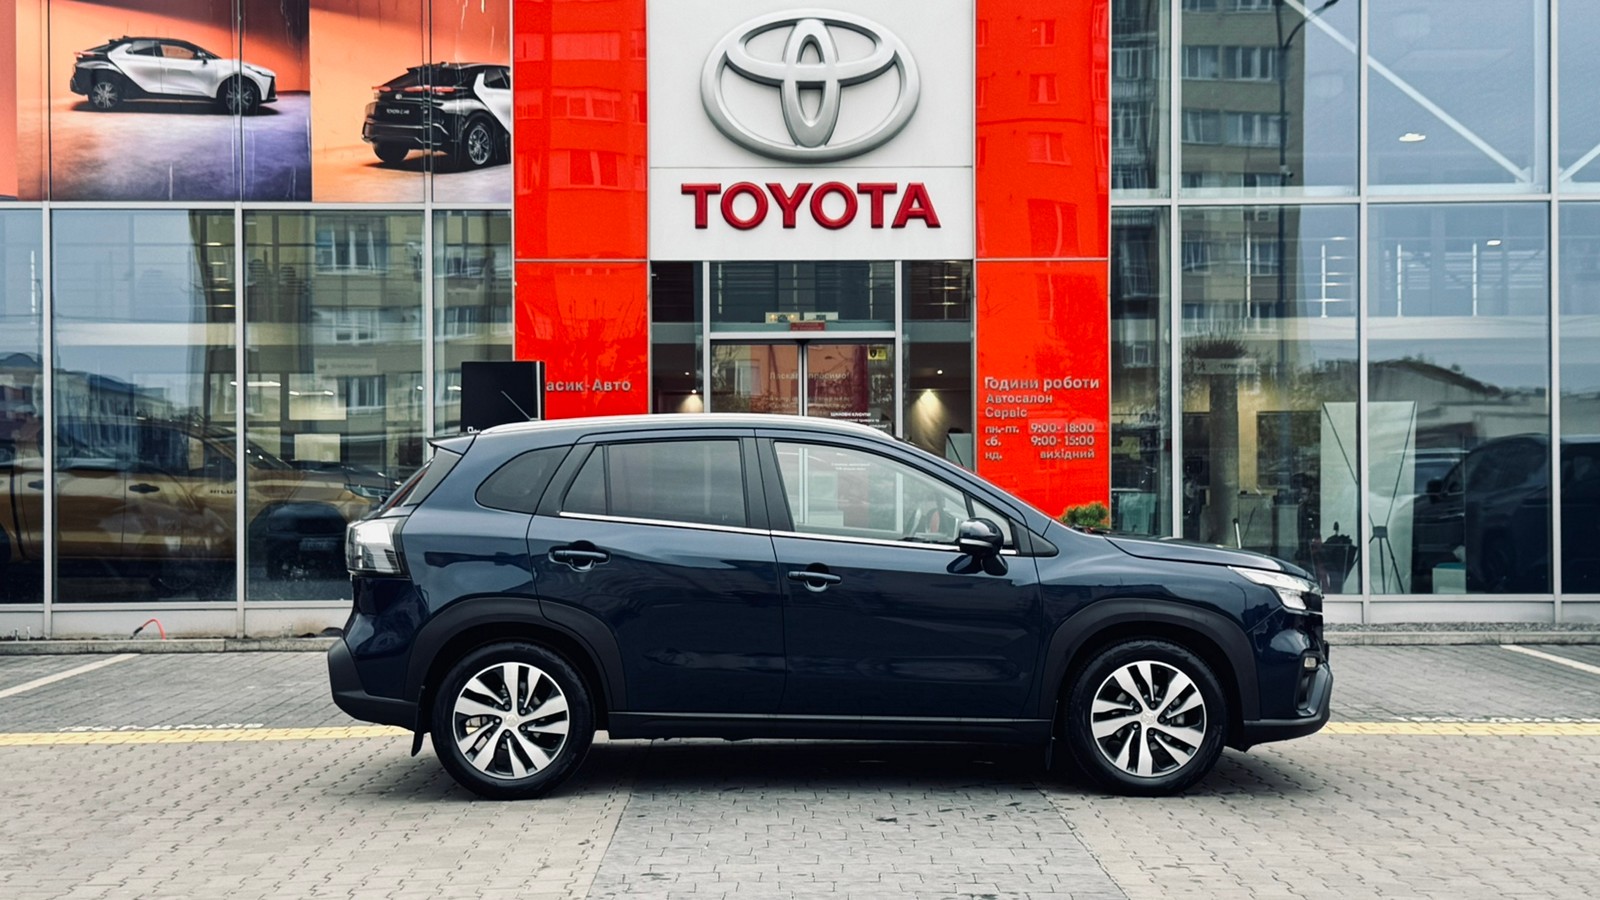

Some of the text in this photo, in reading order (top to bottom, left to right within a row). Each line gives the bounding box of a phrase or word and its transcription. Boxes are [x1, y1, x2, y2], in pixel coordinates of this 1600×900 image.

[681, 181, 941, 230] TOYOTA
[546, 379, 632, 392] асик-Авто
[984, 376, 1100, 392] Години роботи
[986, 394, 1054, 403] Автосалон
[985, 407, 1028, 420] Сервіс
[985, 435, 1002, 446] сб.
[985, 449, 1095, 460] нд. вихідний
